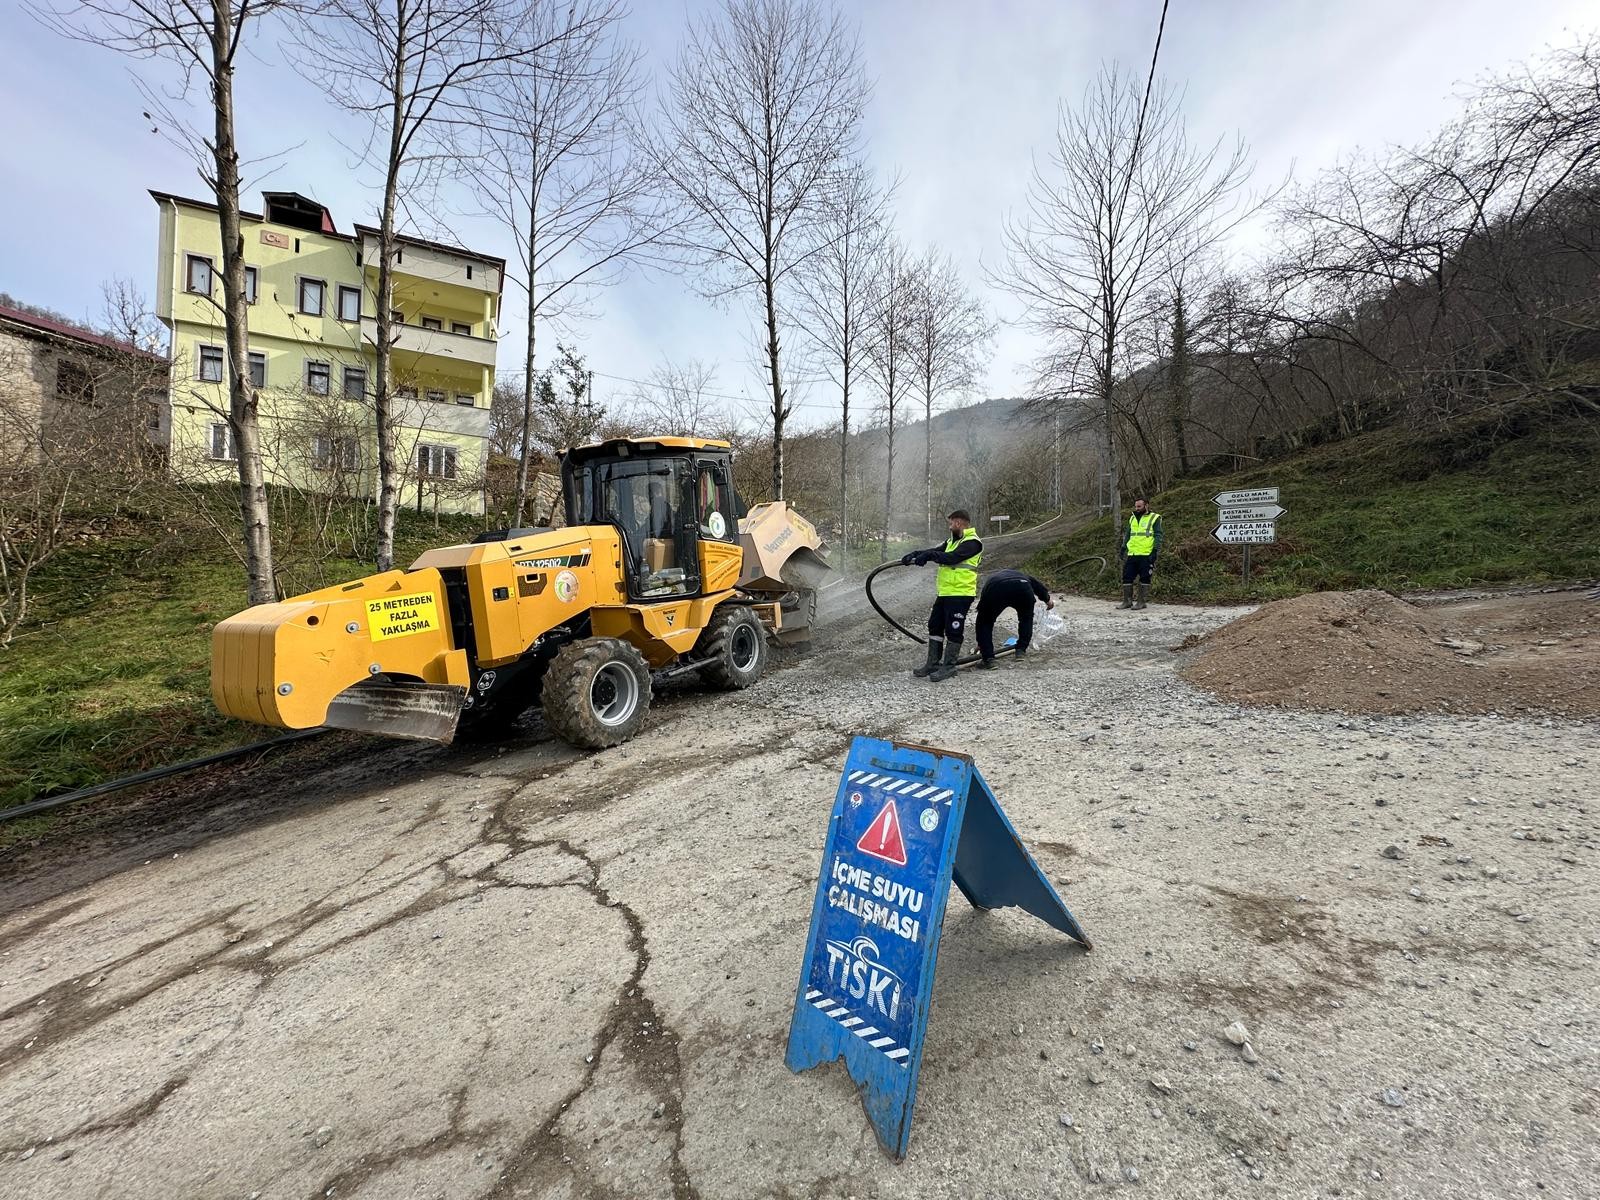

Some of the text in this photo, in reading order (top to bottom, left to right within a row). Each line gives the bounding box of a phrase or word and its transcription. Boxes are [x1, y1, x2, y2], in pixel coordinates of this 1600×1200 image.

[369, 595, 433, 613] 25 METREDEN
[390, 609, 419, 622] FAZLA
[381, 619, 431, 636] YAKLAŞMA
[832, 856, 924, 913] İÇME SUYU
[828, 885, 920, 943] ÇALIŞMASI
